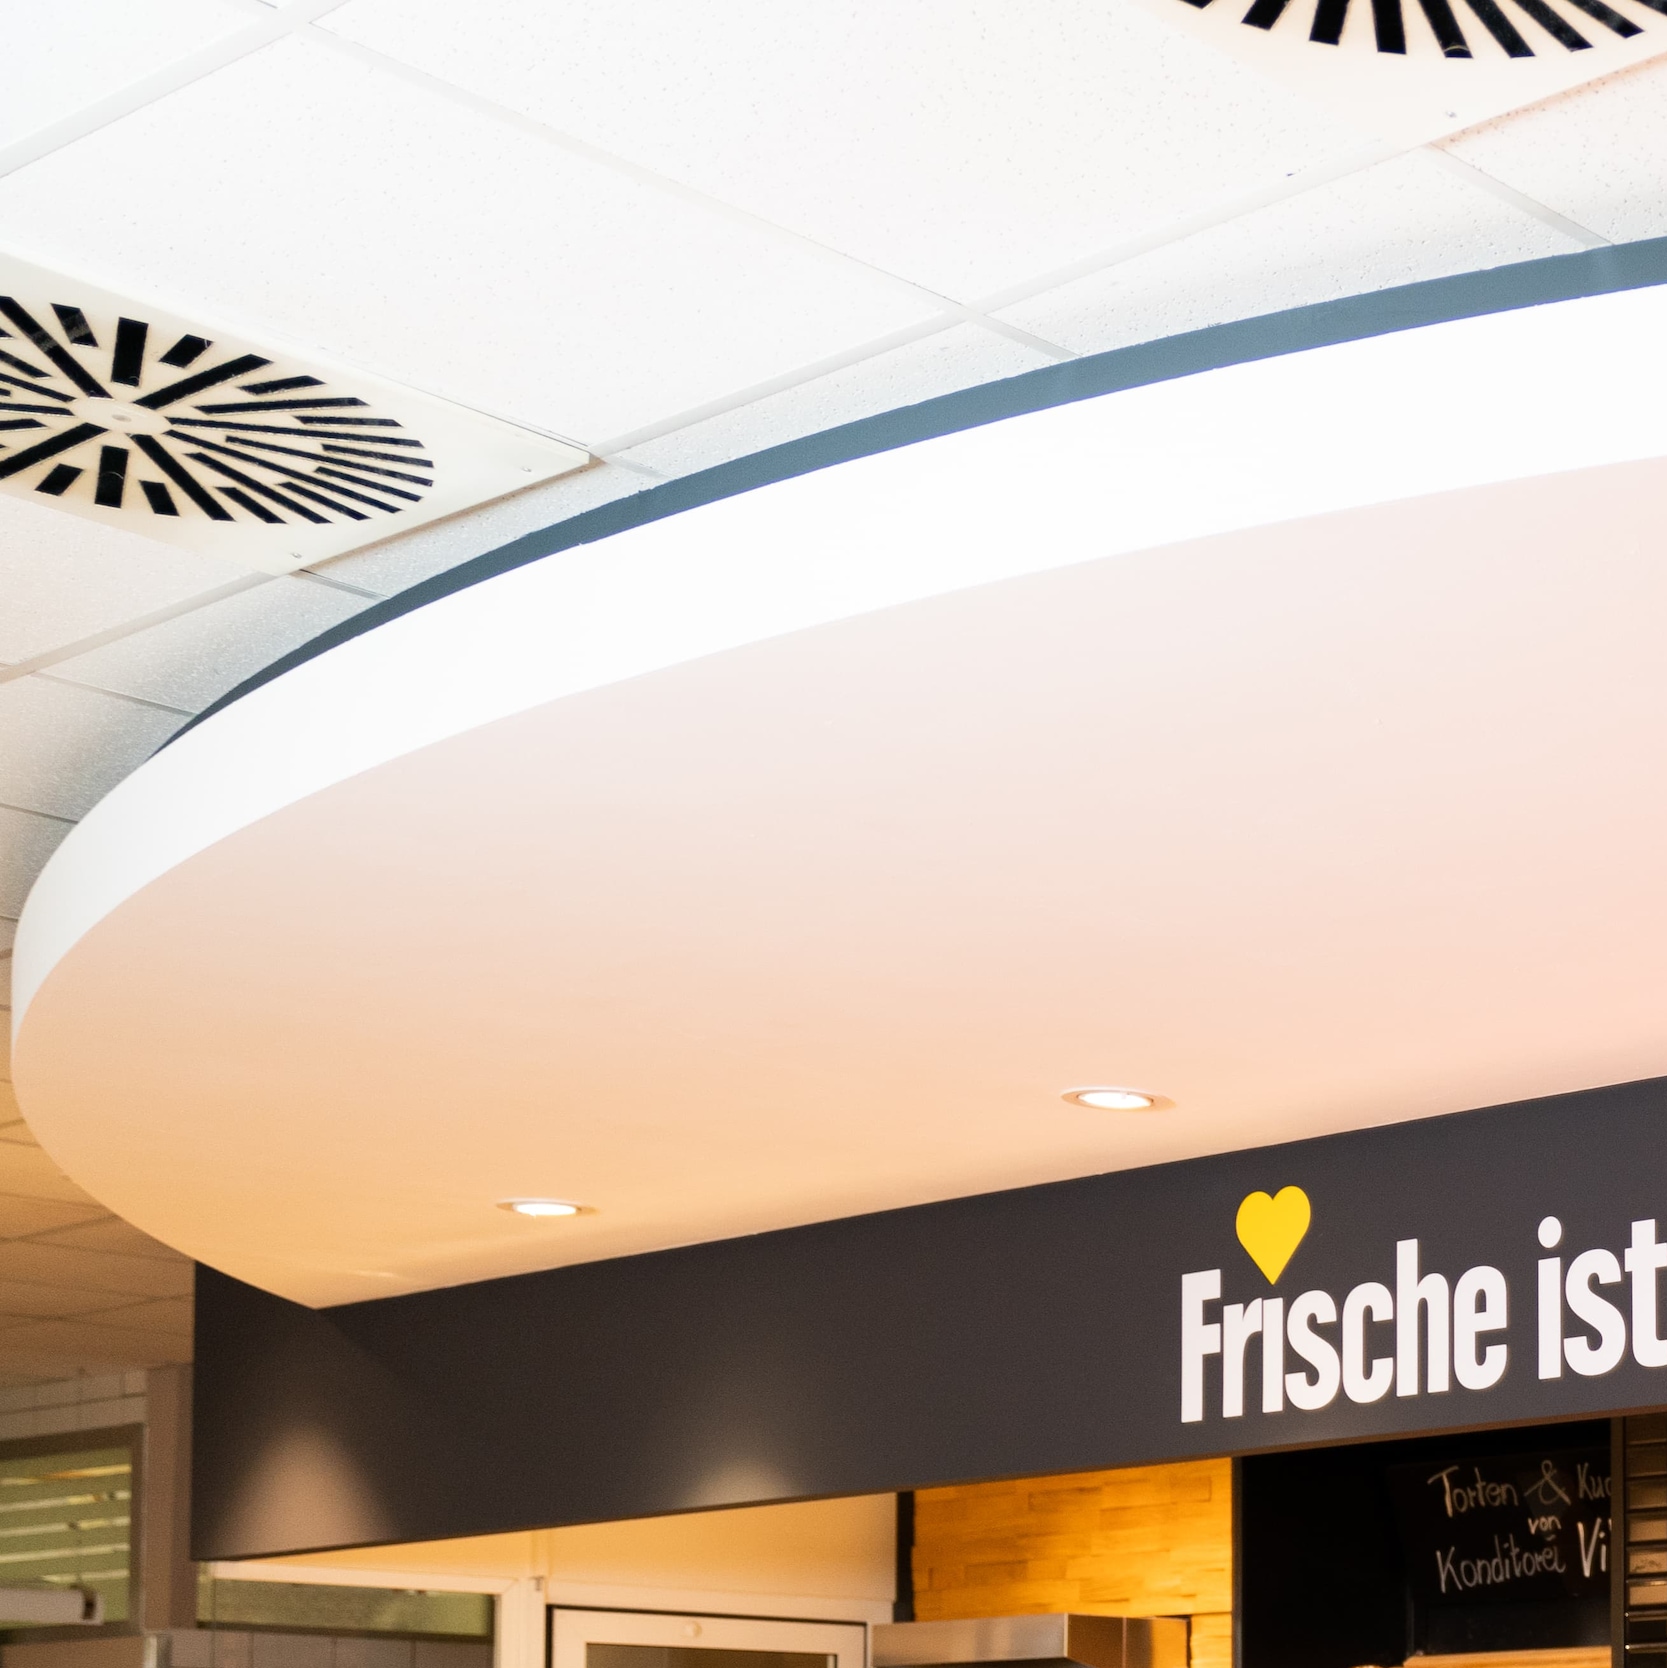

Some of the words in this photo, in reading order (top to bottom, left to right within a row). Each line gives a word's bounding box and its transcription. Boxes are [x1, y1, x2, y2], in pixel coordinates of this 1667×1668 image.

[1180, 1239, 1507, 1423] Frische
[1427, 1466, 1519, 1517] Torten
[1523, 1459, 1571, 1506] &
[1527, 1515, 1561, 1534] von
[1435, 1533, 1566, 1593] Konditorei
